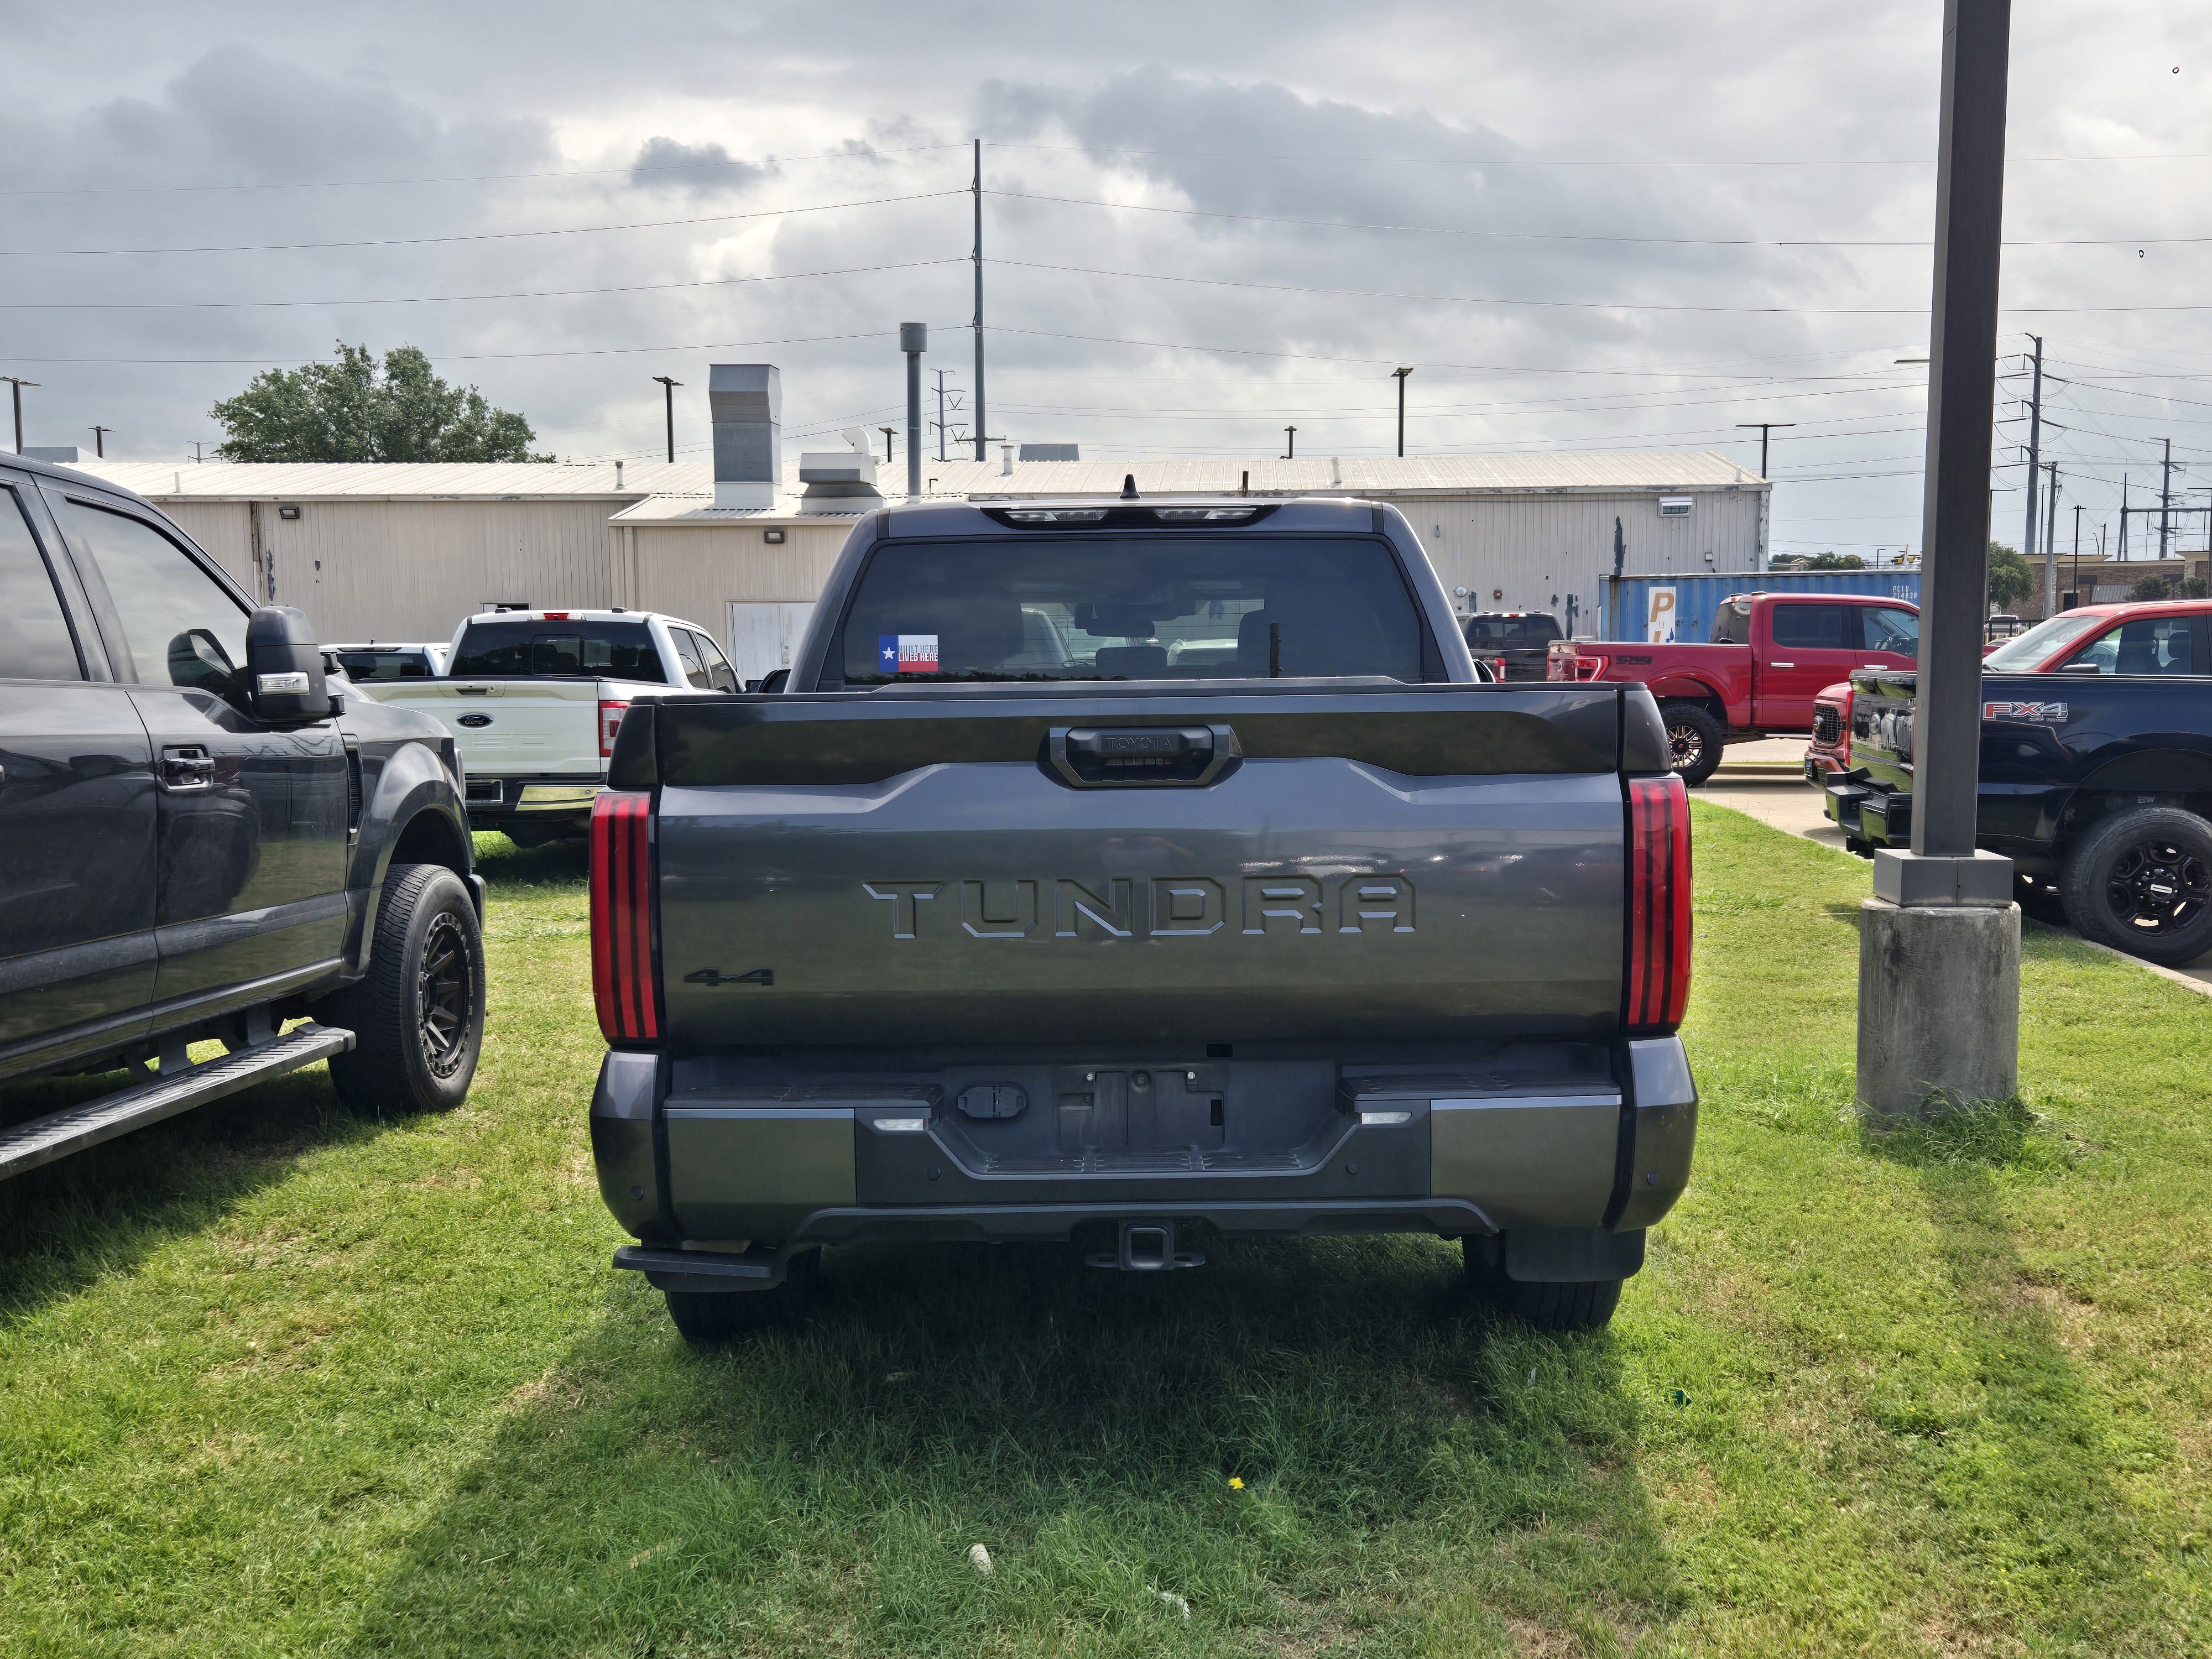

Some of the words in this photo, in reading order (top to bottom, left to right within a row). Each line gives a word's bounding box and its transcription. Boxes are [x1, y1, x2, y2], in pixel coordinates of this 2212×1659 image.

[899, 645, 919, 654] BUILT
[920, 645, 938, 654] HERE
[899, 653, 918, 661] LIVES
[920, 653, 938, 661] HERE
[1983, 701, 2069, 721] FX4
[465, 716, 485, 725] Ford
[1106, 737, 1173, 750] TOYOTA
[862, 874, 1417, 939] TUNDRA
